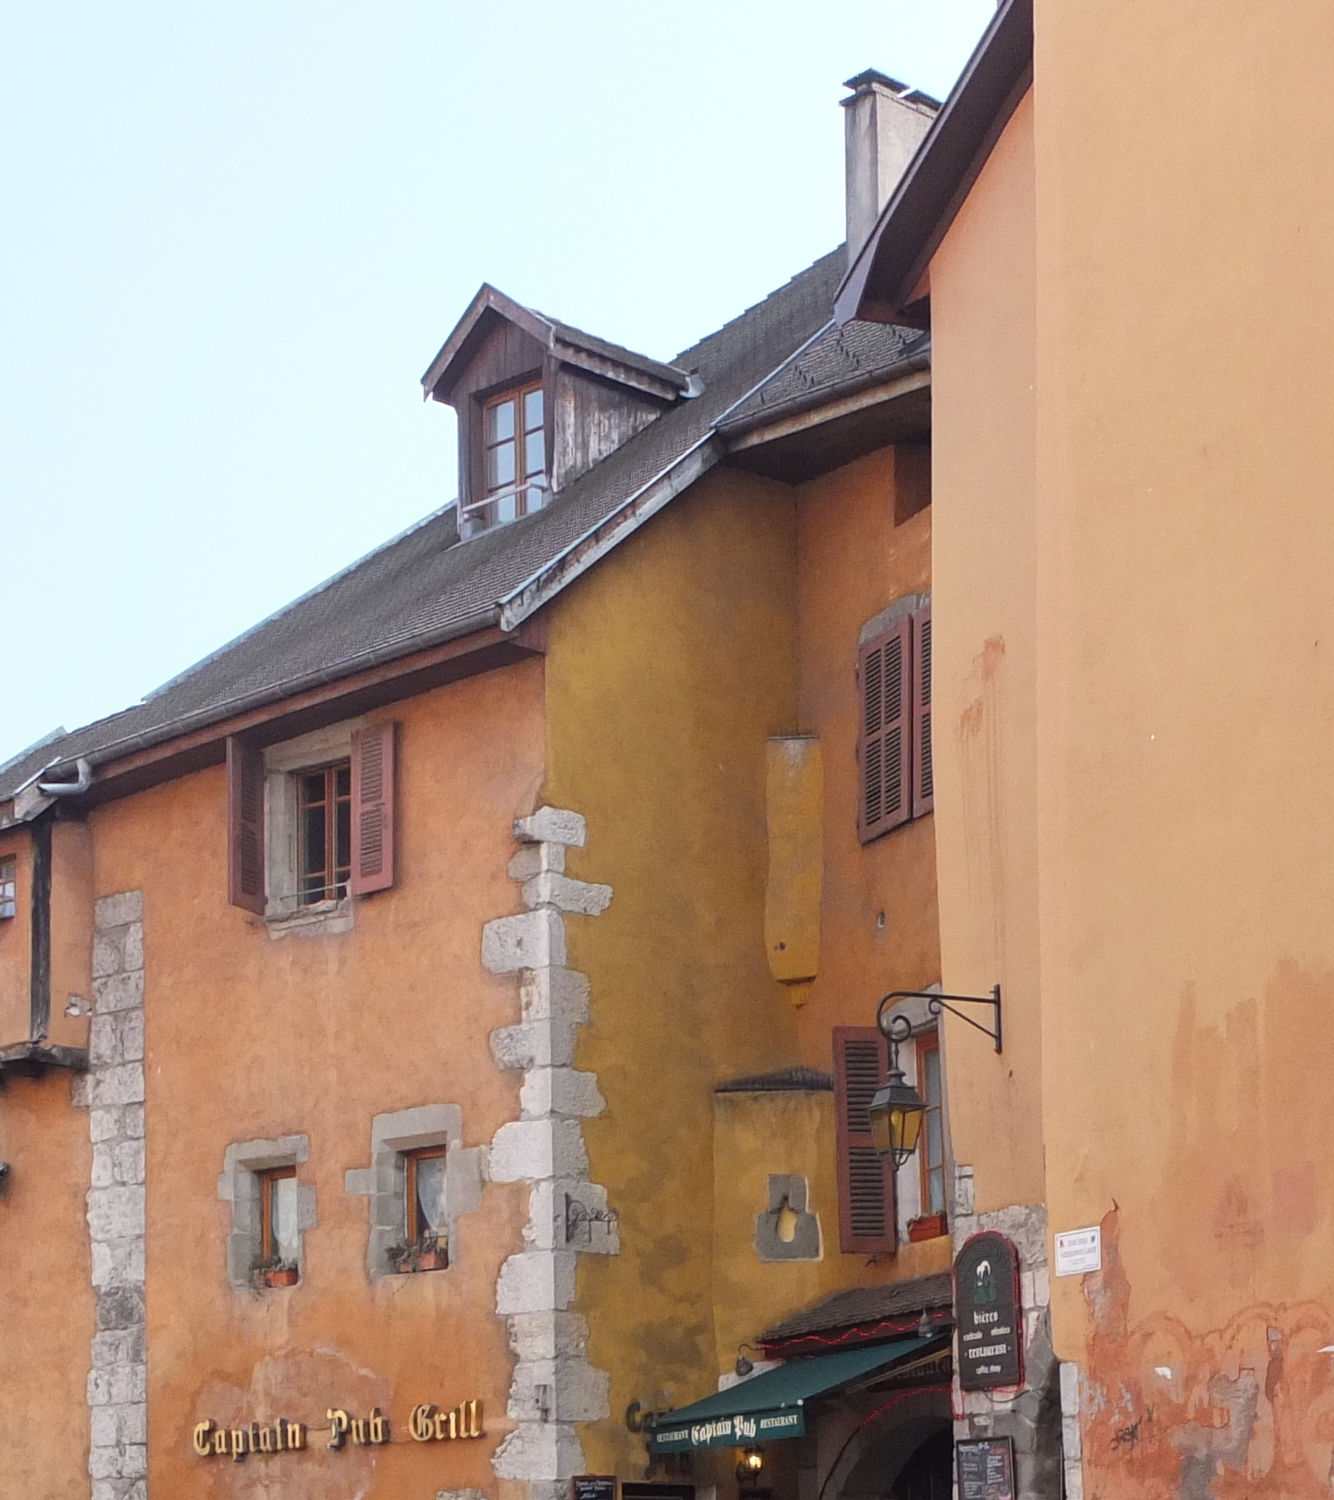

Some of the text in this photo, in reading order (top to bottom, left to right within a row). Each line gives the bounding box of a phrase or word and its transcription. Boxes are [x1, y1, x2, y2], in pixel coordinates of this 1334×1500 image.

[193, 1399, 483, 1461] Captain Pub Grill
[691, 1418, 732, 1446] Captain
[733, 1415, 756, 1441] Pub
